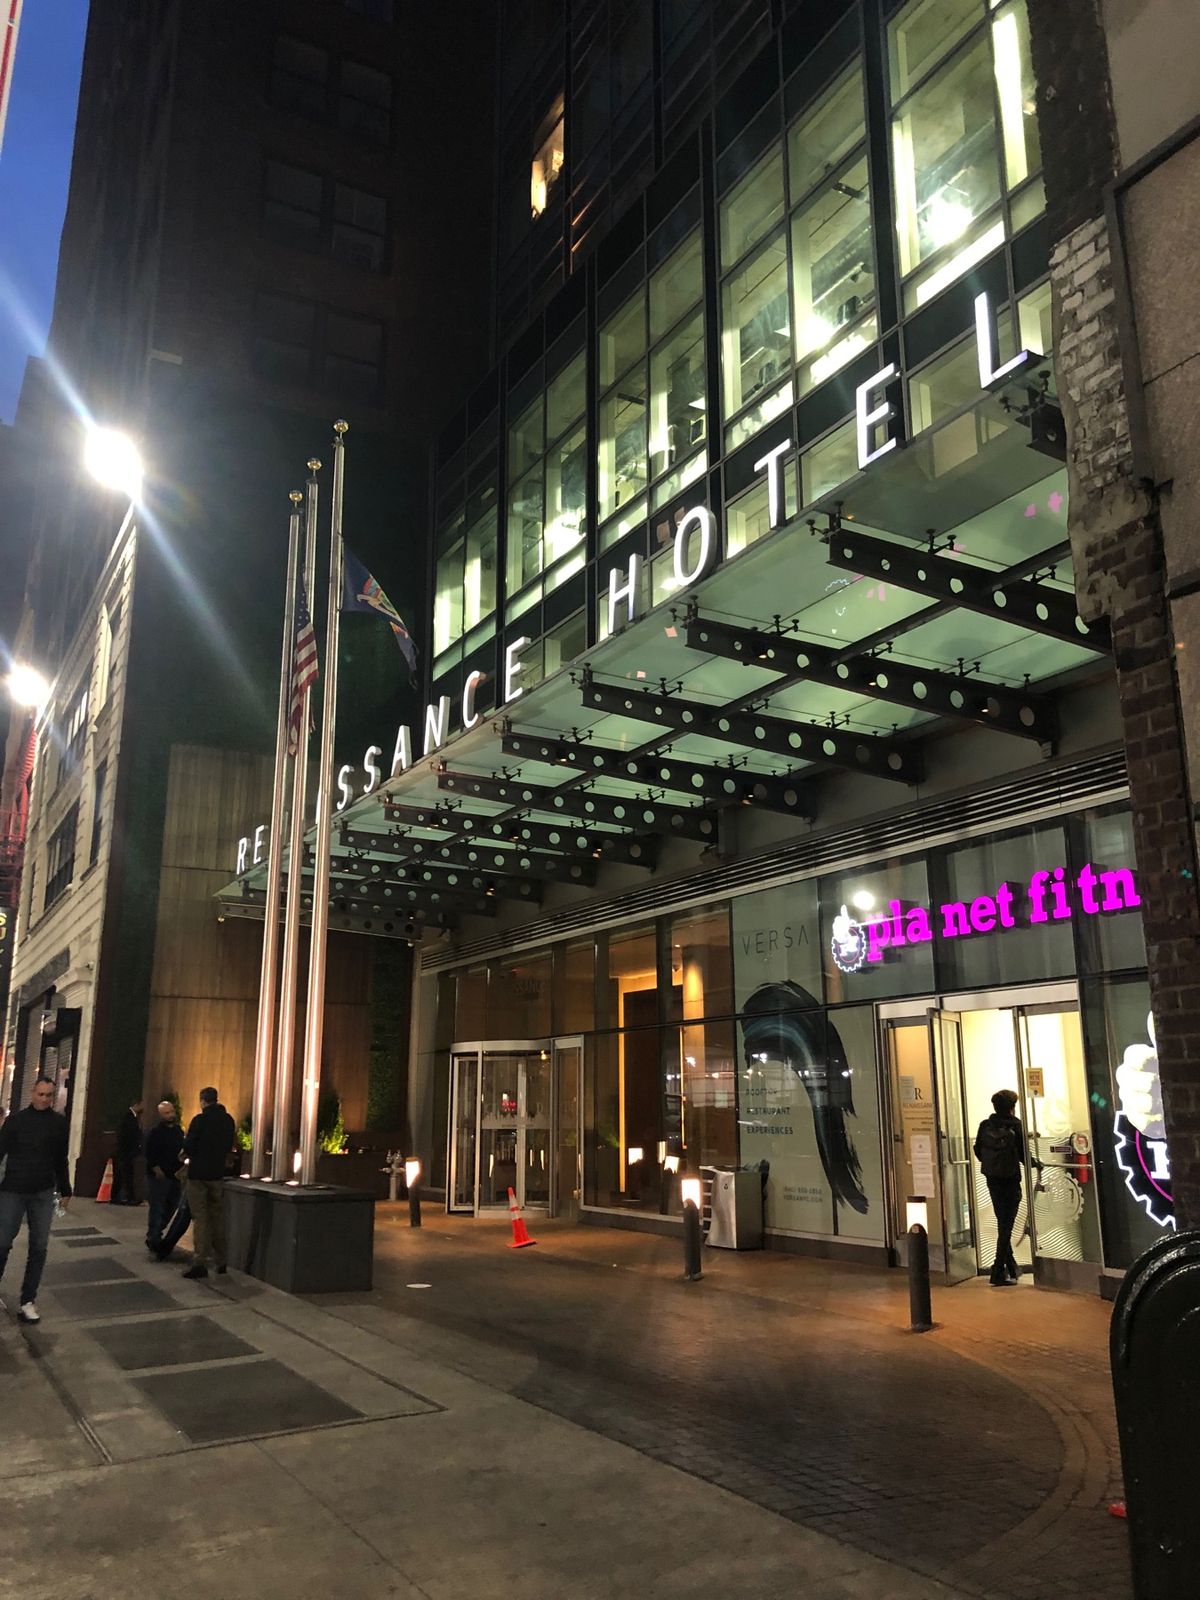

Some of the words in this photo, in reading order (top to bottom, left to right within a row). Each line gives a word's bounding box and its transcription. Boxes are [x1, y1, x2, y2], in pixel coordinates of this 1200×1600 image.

[236, 636, 532, 875] RESSANCE
[607, 291, 1032, 635] HOTEL
[867, 882, 1015, 962] planet
[742, 925, 809, 956] VERSA
[914, 1087, 923, 1101] R
[746, 1125, 794, 1136] EXPERIENCES
